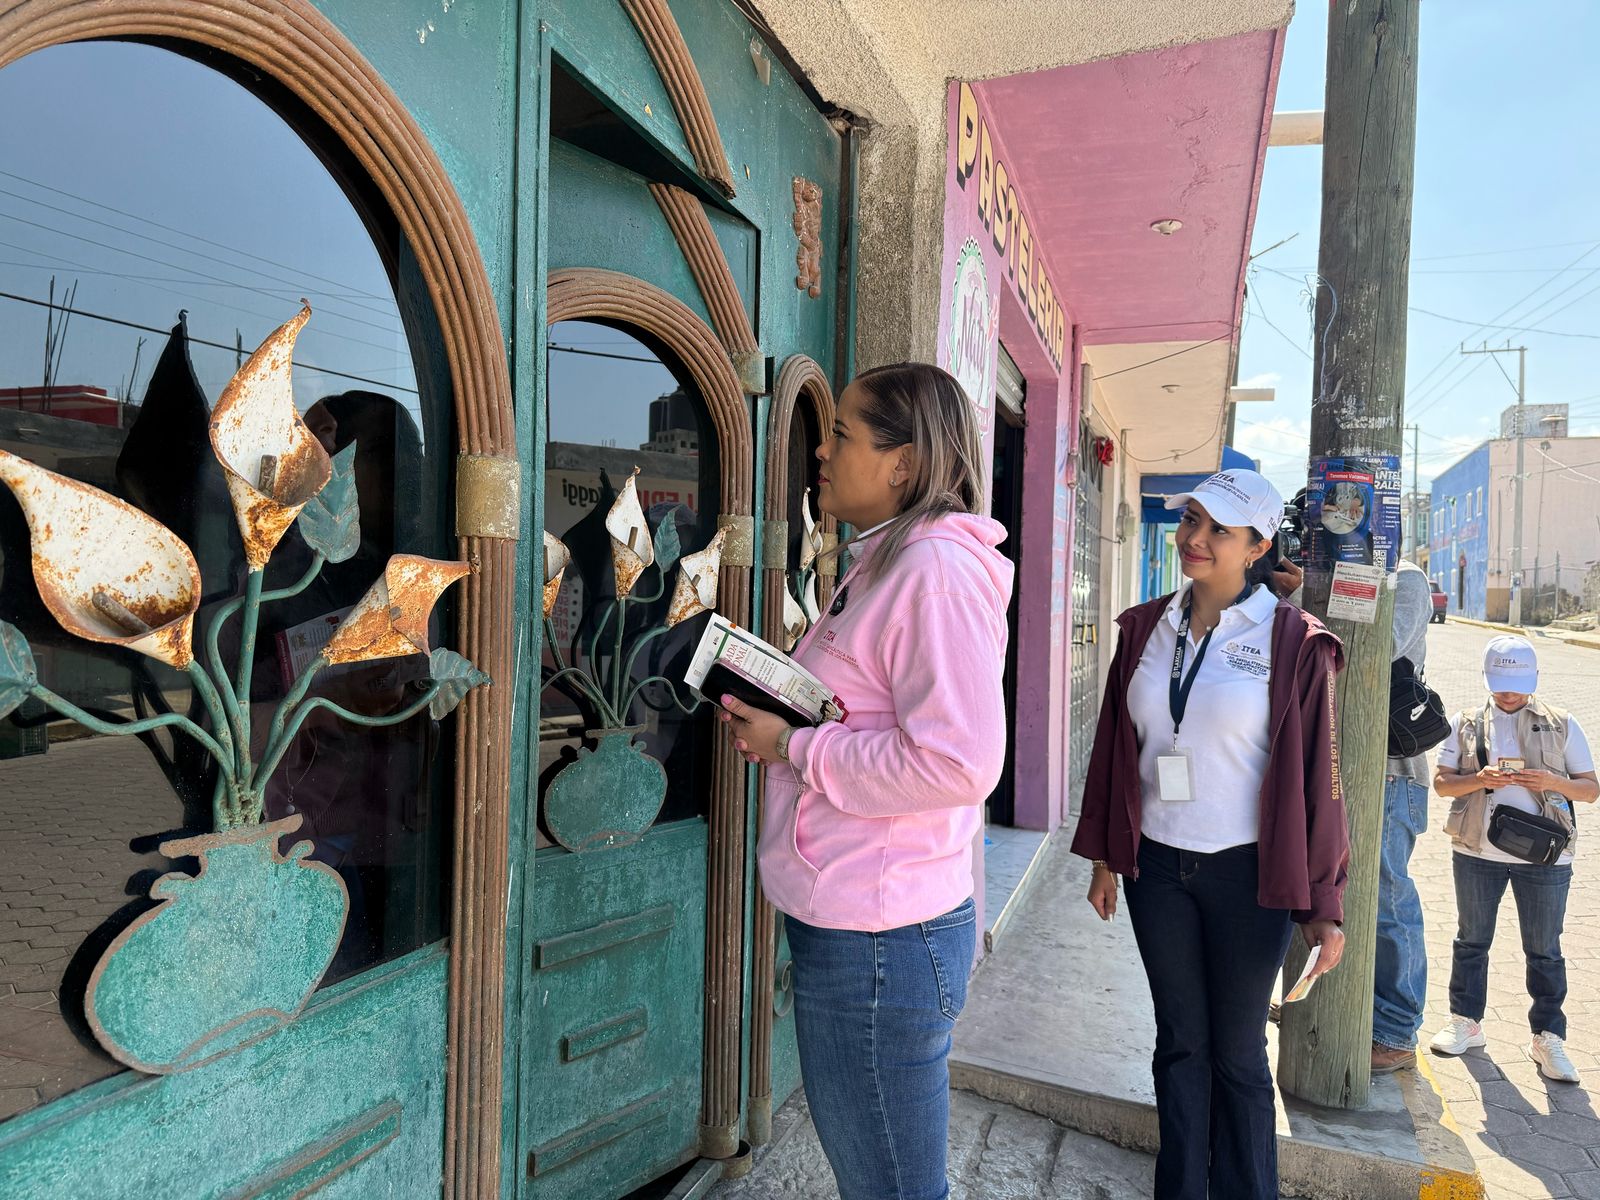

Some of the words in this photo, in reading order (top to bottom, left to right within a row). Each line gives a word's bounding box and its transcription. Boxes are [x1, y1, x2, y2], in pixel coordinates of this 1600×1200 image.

[956, 82, 1066, 375] PASTELERIA
[1173, 646, 1182, 671] TLAXCALA
[1240, 645, 1261, 655] ITEA
[1330, 730, 1337, 741] DE
[1330, 744, 1338, 760] LOS
[1331, 761, 1340, 800] ADULTOS
